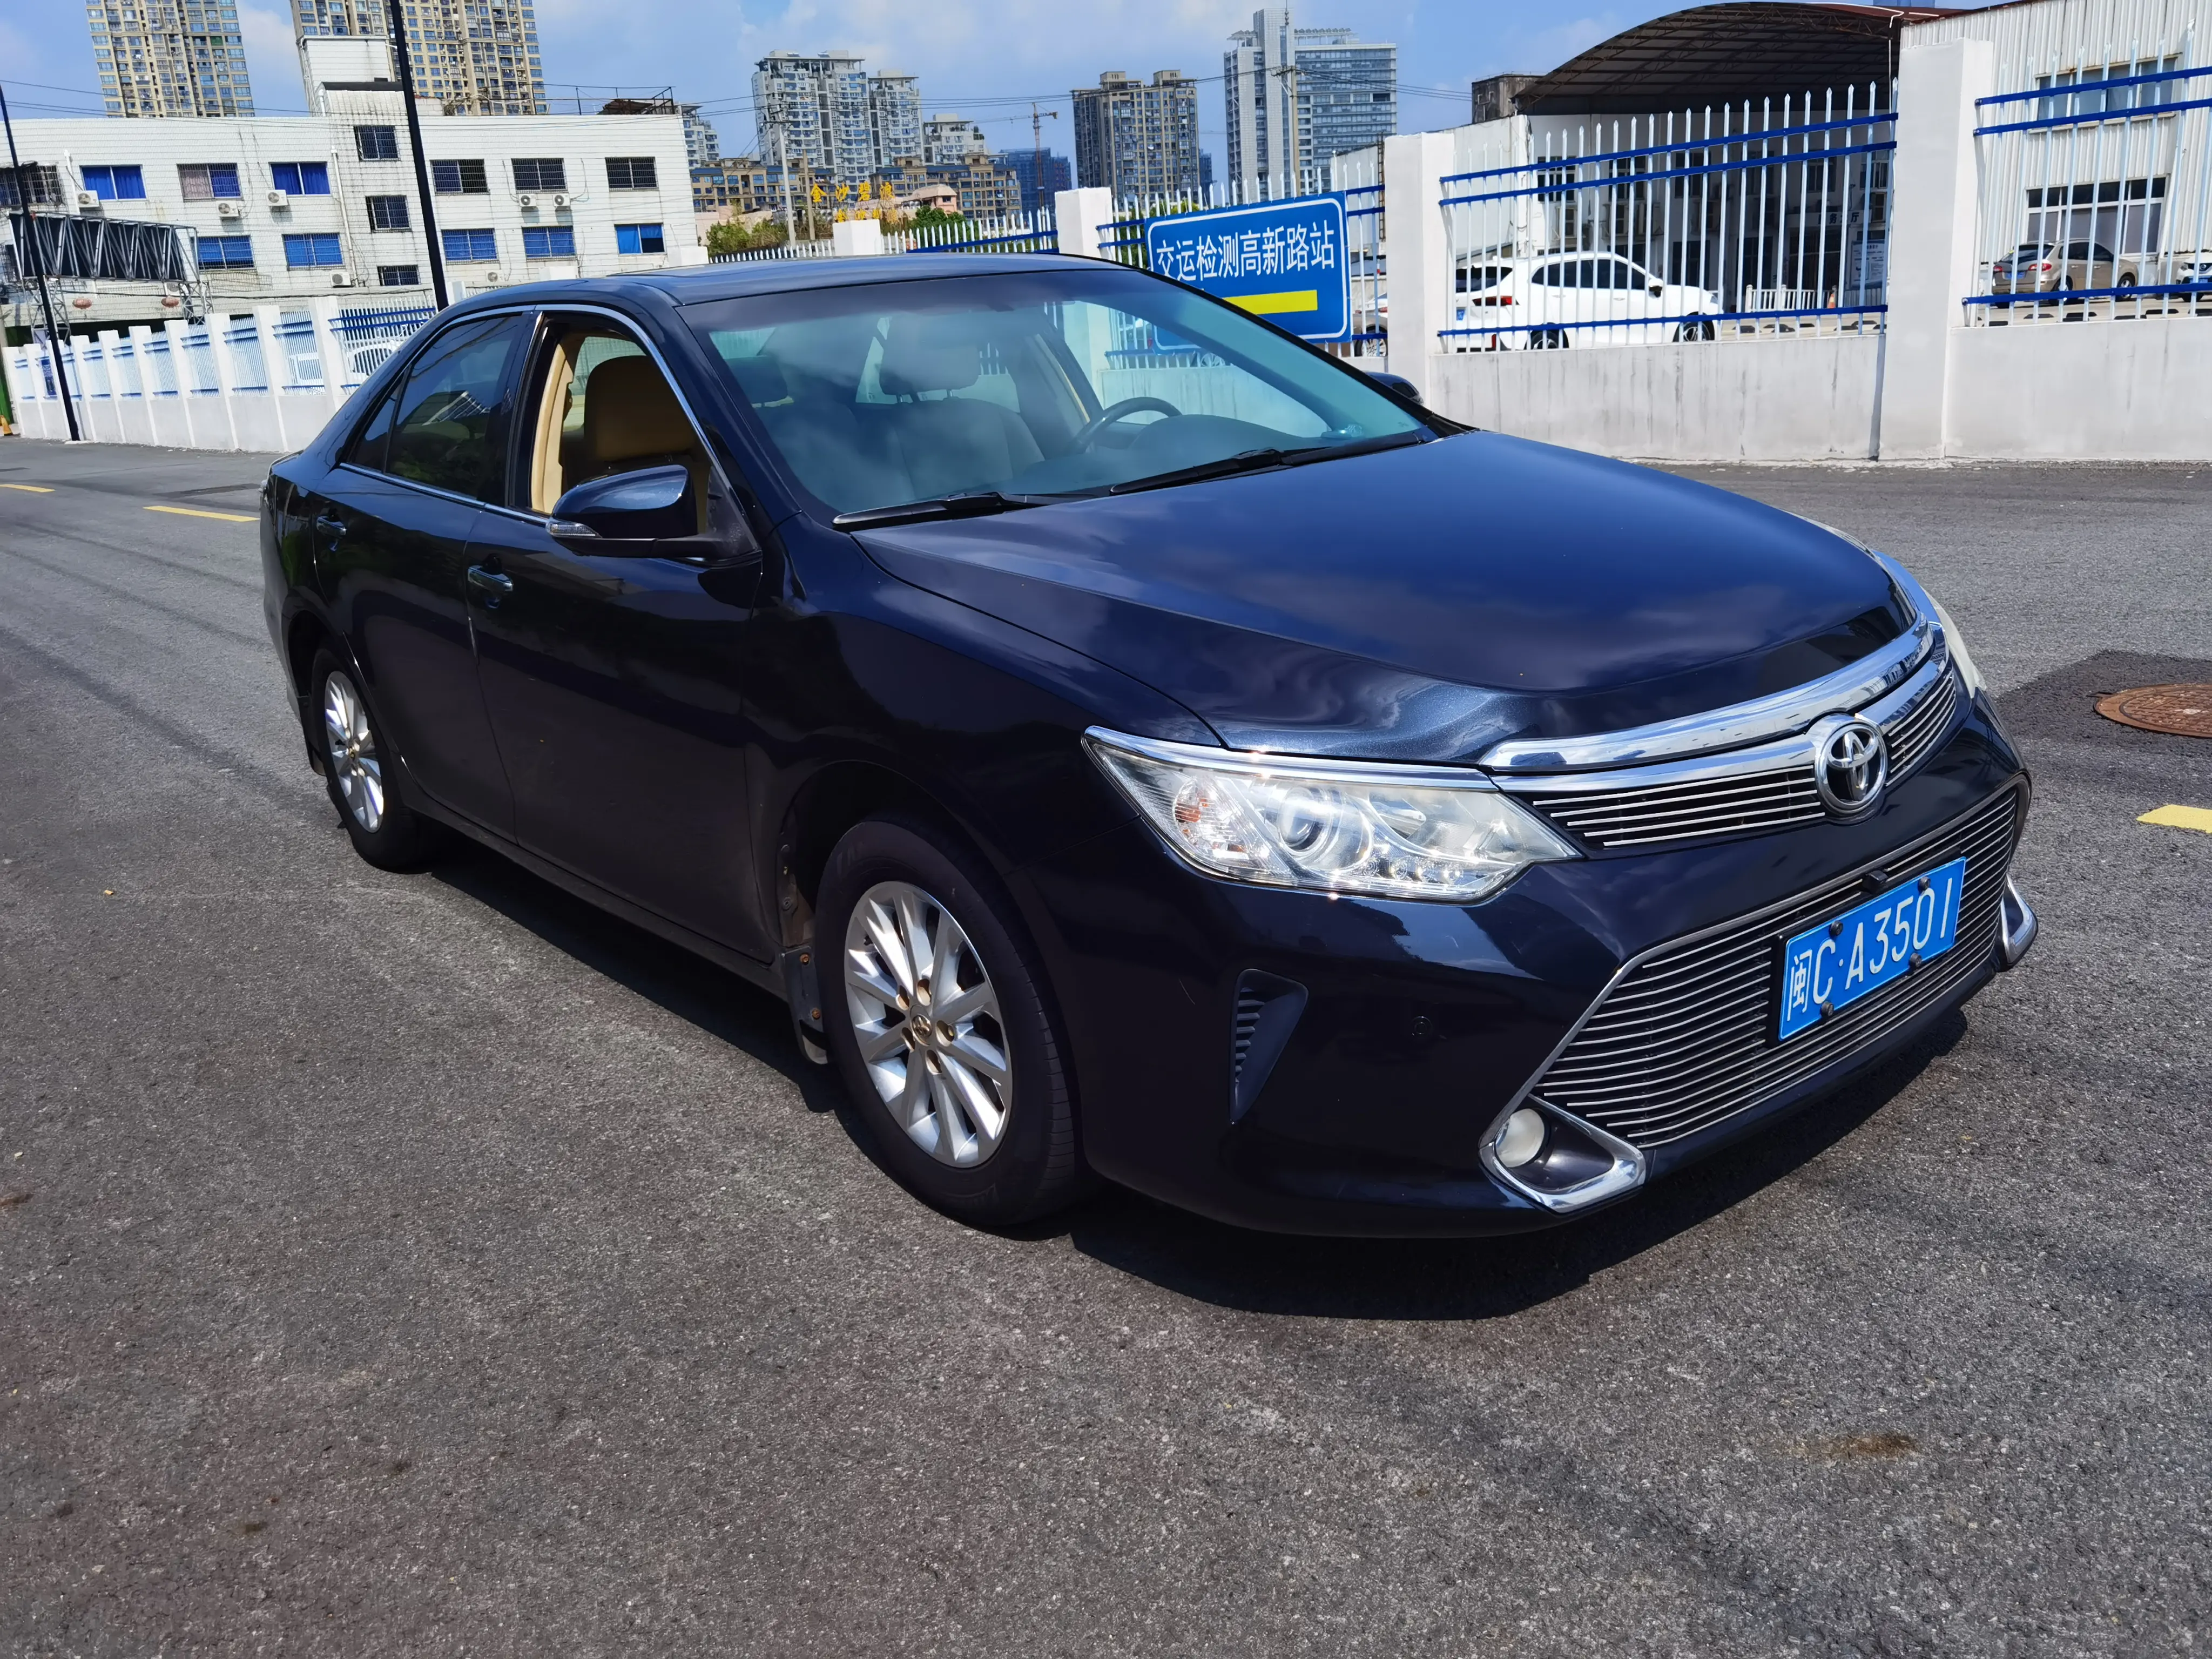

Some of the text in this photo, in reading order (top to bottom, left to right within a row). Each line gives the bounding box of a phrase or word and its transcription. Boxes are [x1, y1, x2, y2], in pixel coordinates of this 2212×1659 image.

[1156, 219, 1334, 281] 交运检测高新路站
